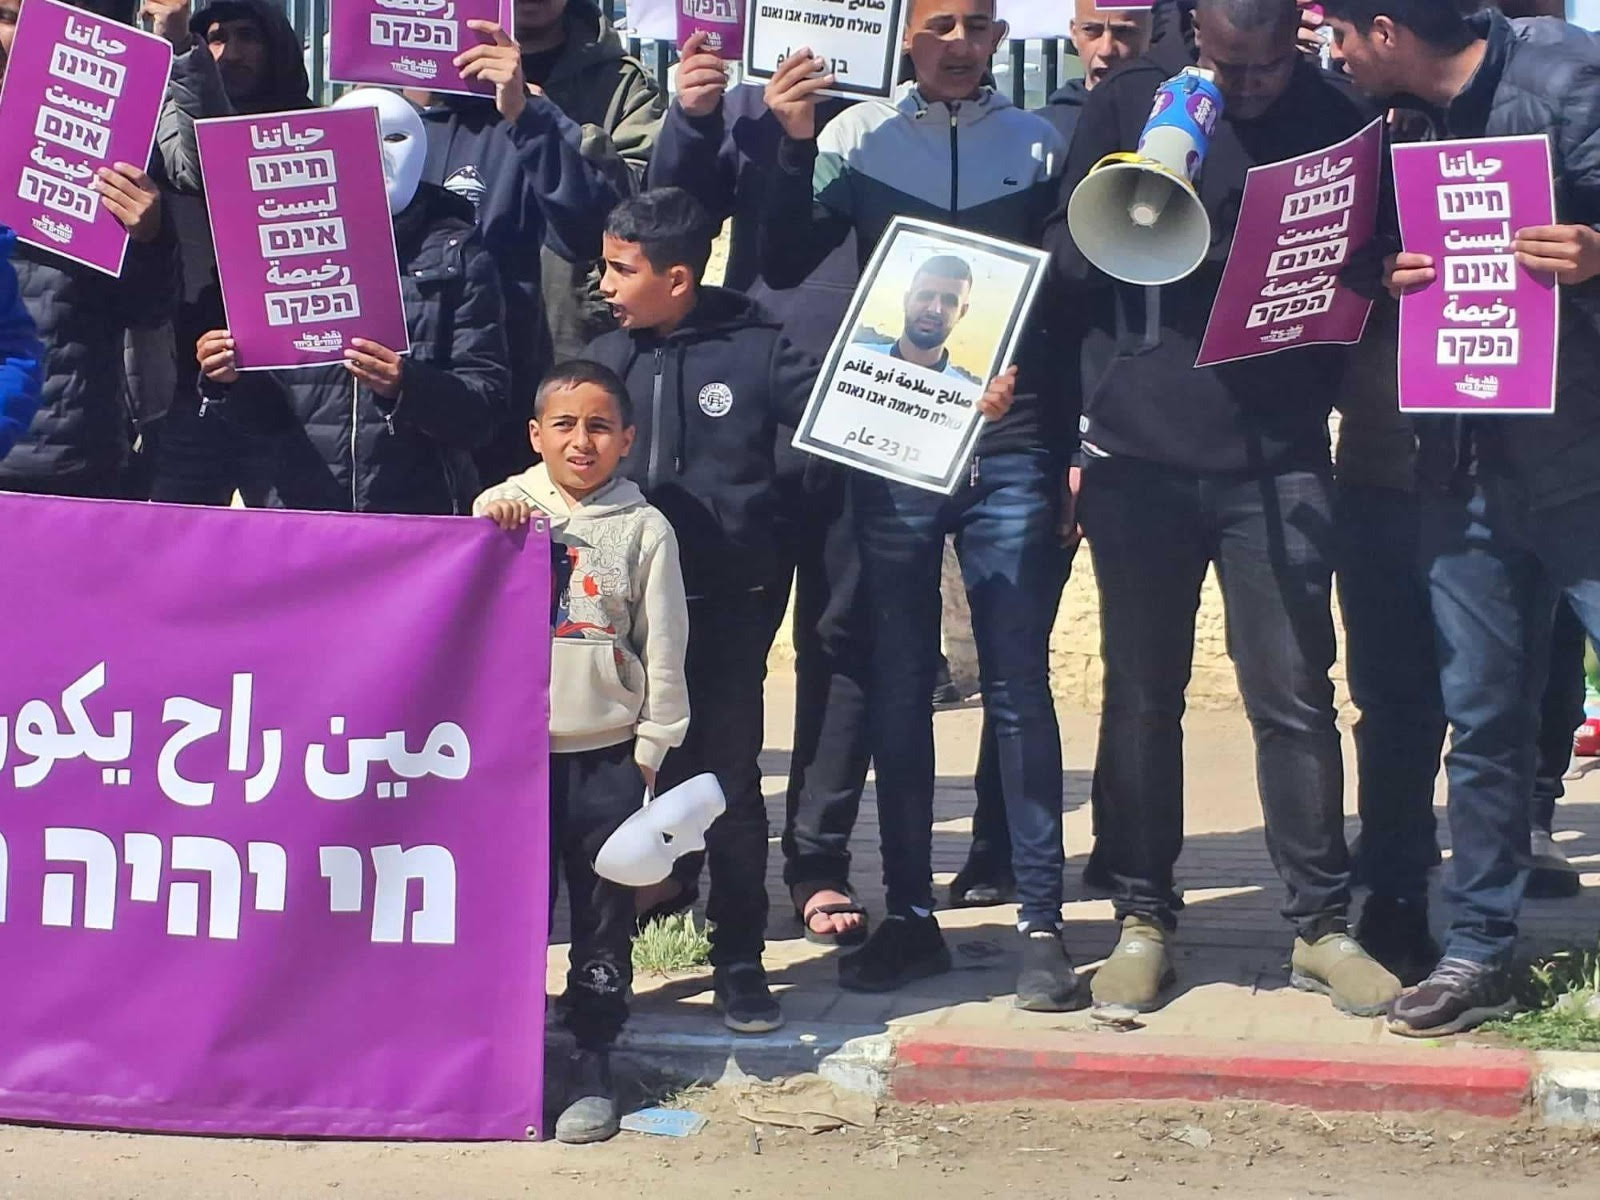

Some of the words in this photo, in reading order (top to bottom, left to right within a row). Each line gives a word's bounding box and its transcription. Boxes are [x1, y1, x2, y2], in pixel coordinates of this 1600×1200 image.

[785, 9, 802, 22] אבו
[803, 12, 845, 29] סלאמה
[847, 18, 882, 34] סאלח
[65, 16, 127, 57] حياتنا
[376, 20, 451, 47] הפקר
[58, 51, 117, 89] חיינו
[46, 85, 115, 122] ليست
[44, 114, 102, 151] אינם
[250, 122, 324, 152] حياتنا
[30, 140, 100, 190] رخيصة
[256, 158, 328, 183] חיינו
[1294, 156, 1353, 187] حياتنا
[1439, 150, 1502, 181] حياتنا
[27, 174, 92, 215] הפקר
[258, 186, 337, 218] ليست
[1290, 184, 1349, 216] חיינו
[1443, 190, 1503, 213] חיינו
[268, 225, 338, 250] אינם
[1277, 209, 1350, 245] ليست
[1444, 221, 1510, 253] ليست
[266, 258, 350, 287] رخيصة
[1276, 244, 1340, 271] אינם
[1261, 271, 1336, 296] رخيصة
[1452, 262, 1509, 284] אינם
[272, 292, 353, 324] הפקר
[1255, 294, 1327, 325] הפקר
[1443, 294, 1516, 328] رخيصة
[1443, 335, 1512, 364] הפקר
[843, 359, 874, 376] غانم
[875, 367, 896, 385] أبو
[866, 390, 887, 406] אבו
[895, 371, 936, 396] سلامة
[936, 389, 973, 408] صالح
[887, 397, 929, 419] סלאמה
[843, 426, 875, 445] عام
[878, 438, 900, 456] 23
[0, 659, 133, 788] يكو
[157, 672, 282, 806] راح
[304, 716, 471, 800] مين
[42, 826, 287, 940] יהיה
[319, 844, 457, 944] מי
